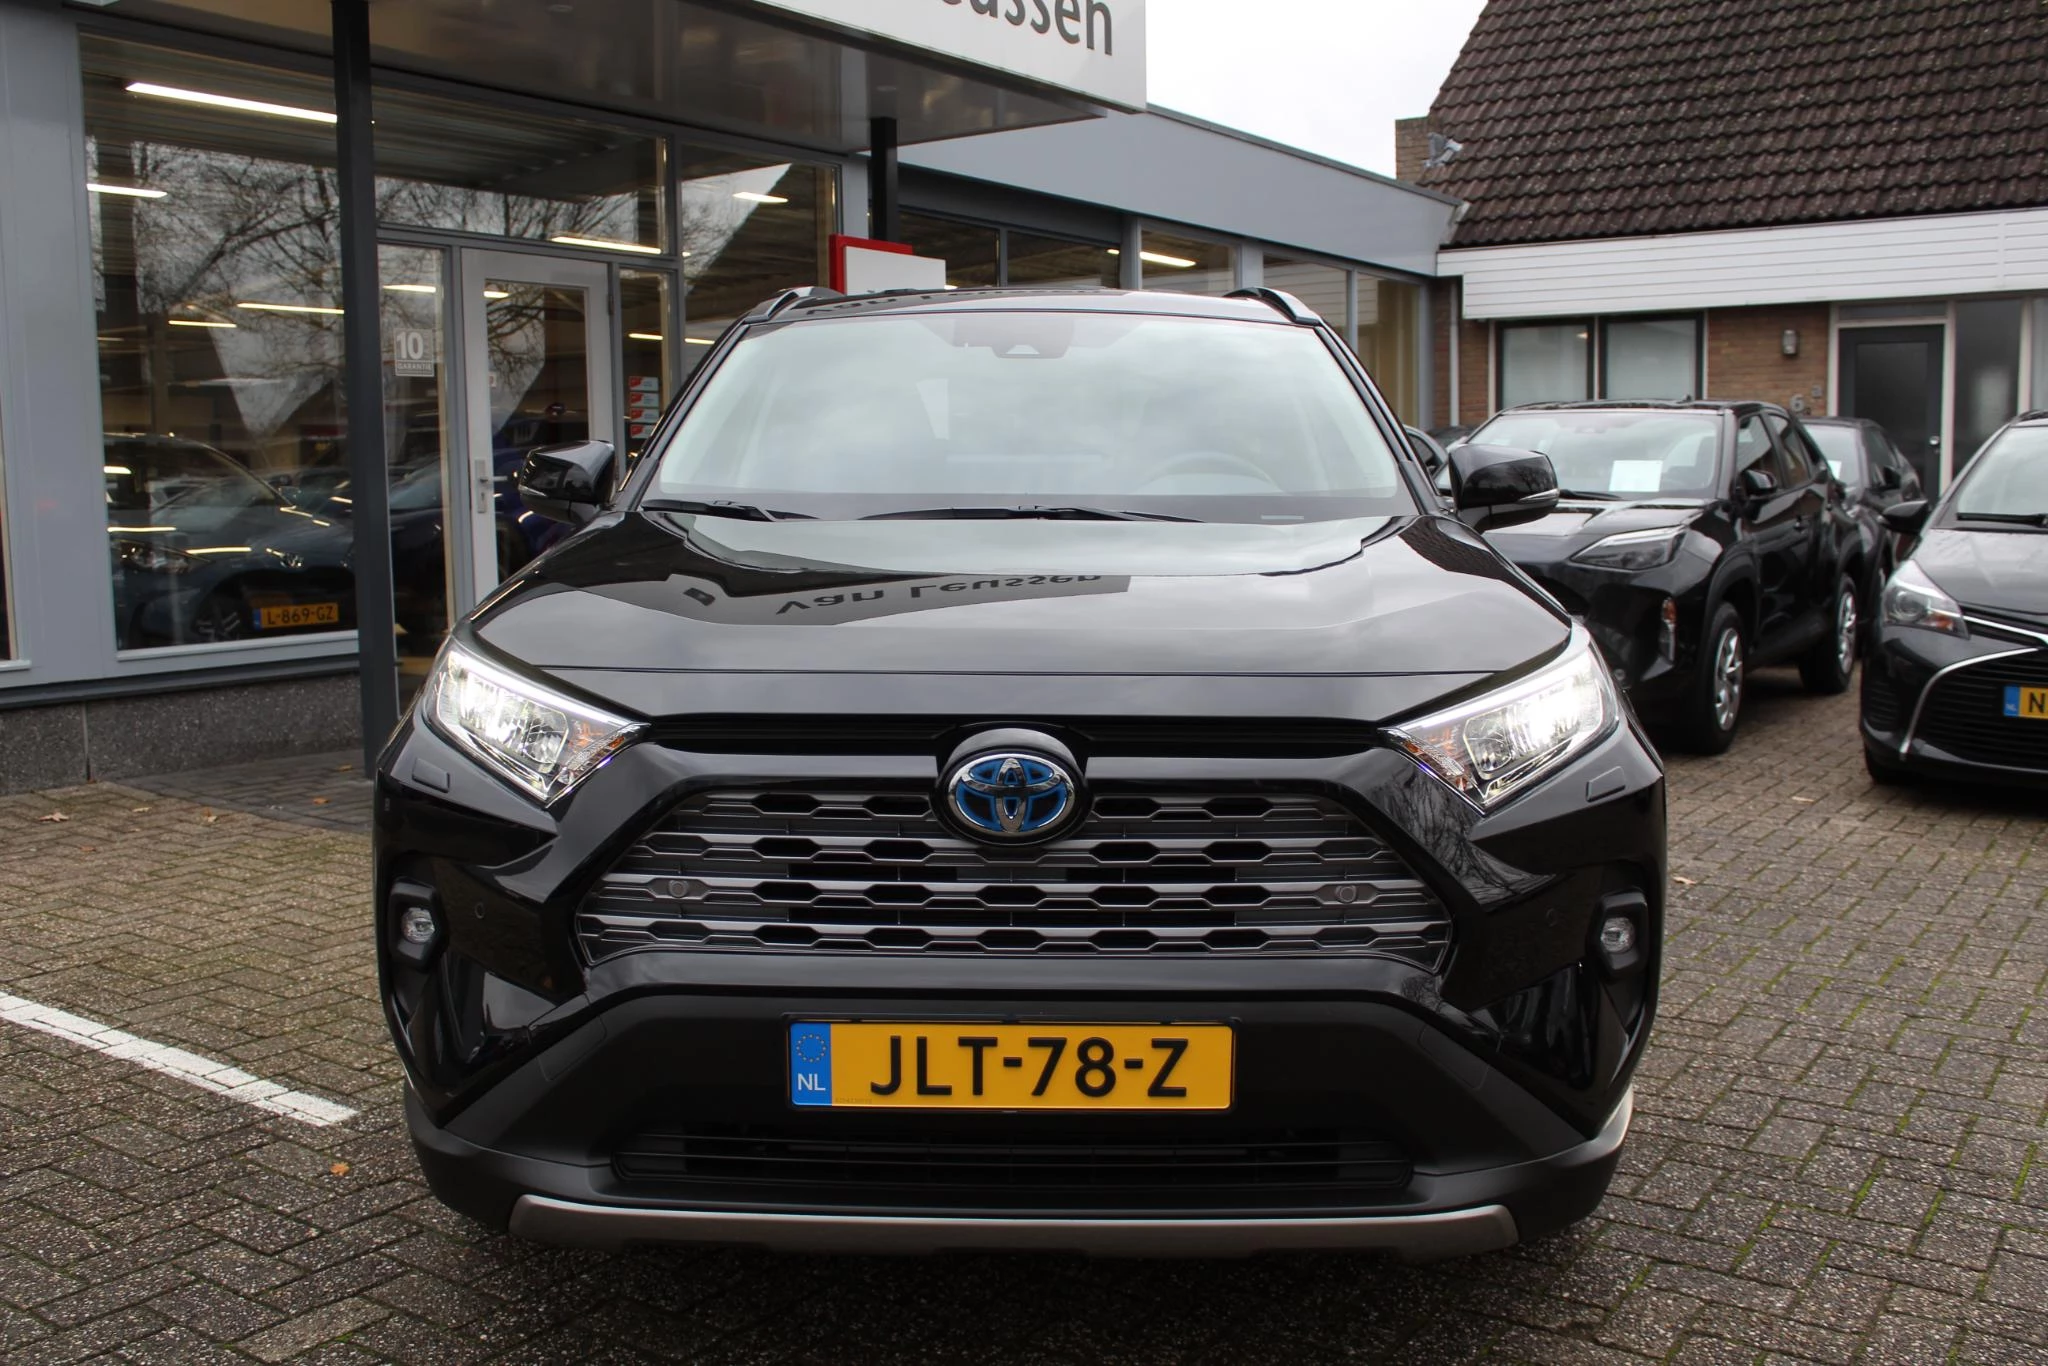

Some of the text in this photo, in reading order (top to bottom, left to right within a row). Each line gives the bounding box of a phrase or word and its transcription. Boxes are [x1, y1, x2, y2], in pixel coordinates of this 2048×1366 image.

[396, 331, 424, 359] 10
[2029, 692, 2045, 713] N
[870, 1035, 1188, 1098] JLT-78-Z
[798, 1073, 826, 1090] NL
